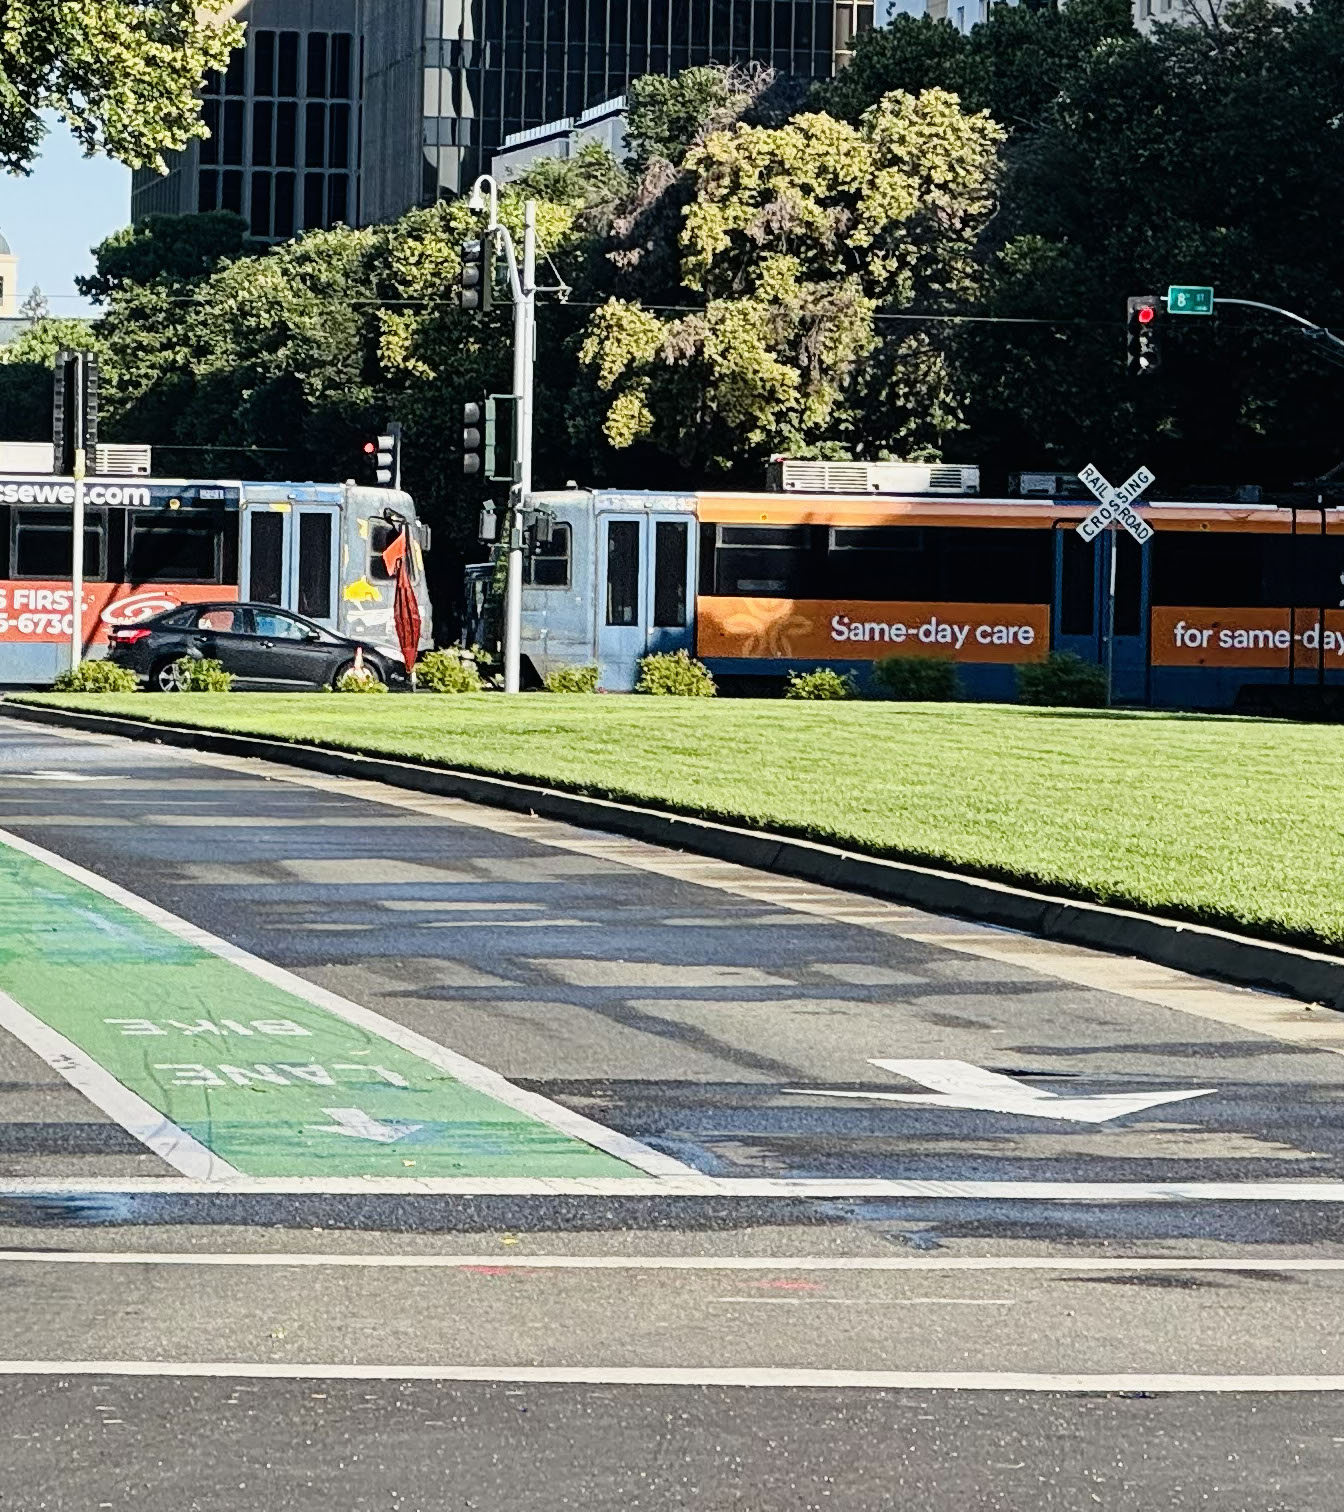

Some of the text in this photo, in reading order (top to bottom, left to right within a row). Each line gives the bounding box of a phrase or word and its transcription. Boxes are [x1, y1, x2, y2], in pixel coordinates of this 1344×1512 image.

[1081, 467, 1149, 540] RAIL ROAD
[1082, 471, 1149, 537] CROSSING
[831, 615, 1035, 649] Same-day care
[1173, 621, 1213, 647] for
[102, 1017, 313, 1036] BIKE
[153, 1063, 410, 1086] LANE
